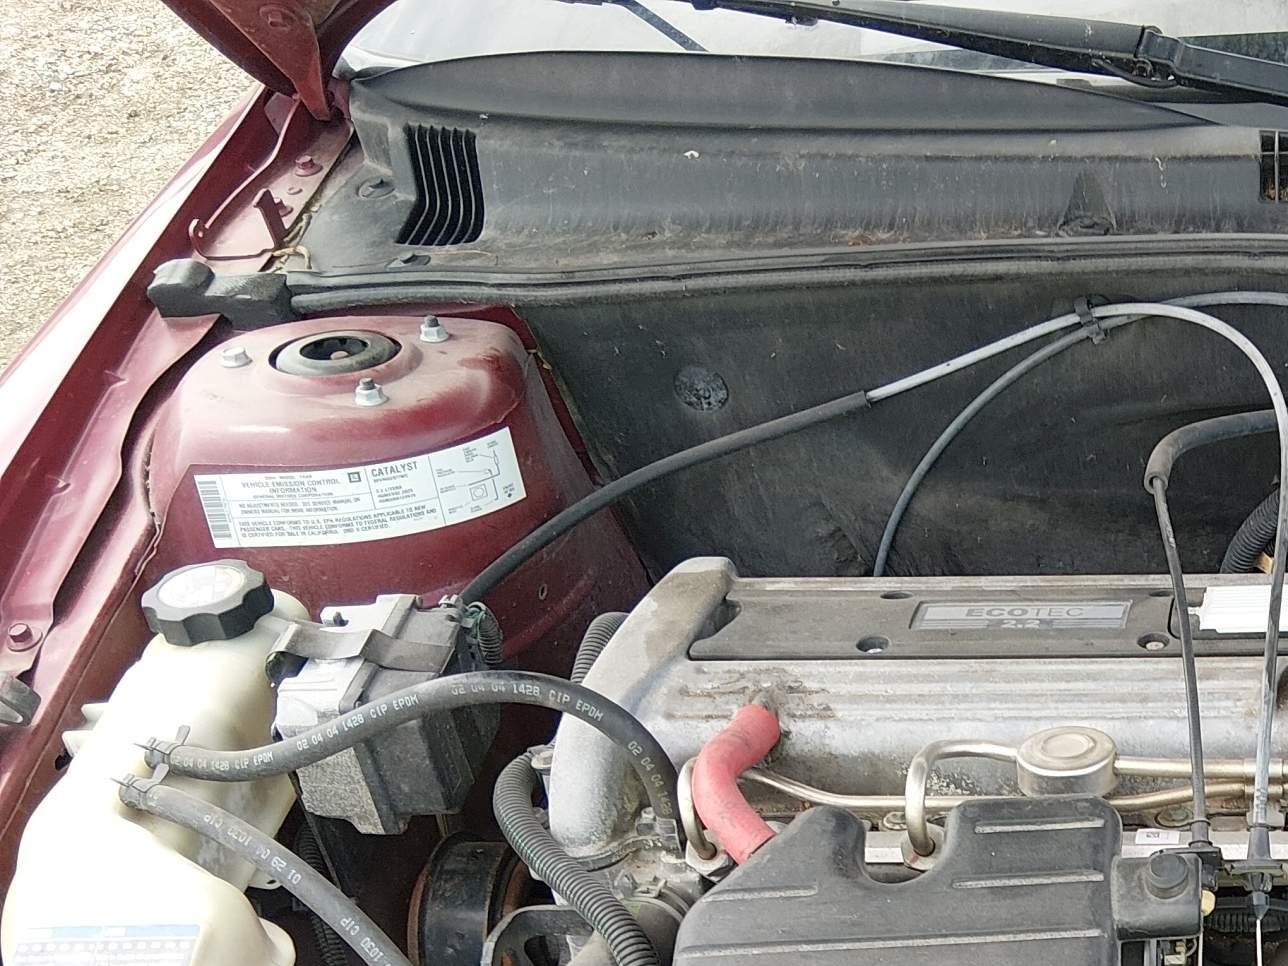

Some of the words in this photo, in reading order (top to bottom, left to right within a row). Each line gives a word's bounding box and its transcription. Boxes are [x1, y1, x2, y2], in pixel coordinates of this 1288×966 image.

[371, 461, 418, 478] CATALYST
[269, 486, 318, 495] INFORMATION
[307, 478, 342, 487] CONTROL
[966, 607, 1084, 617] ECOTEC
[1000, 619, 1041, 629] 2.2
[512, 684, 541, 697] 1428
[549, 690, 571, 705] CIP
[575, 699, 605, 721] EPDM
[296, 740, 309, 751] 02
[311, 733, 324, 746] 04
[327, 726, 340, 739] 04
[342, 712, 365, 733] 1428
[369, 703, 389, 720] CIP
[392, 693, 421, 711] EPDM
[253, 751, 274, 767] EPDM
[627, 739, 644, 757] 02
[640, 756, 656, 772] 04
[339, 916, 360, 937] CIP
